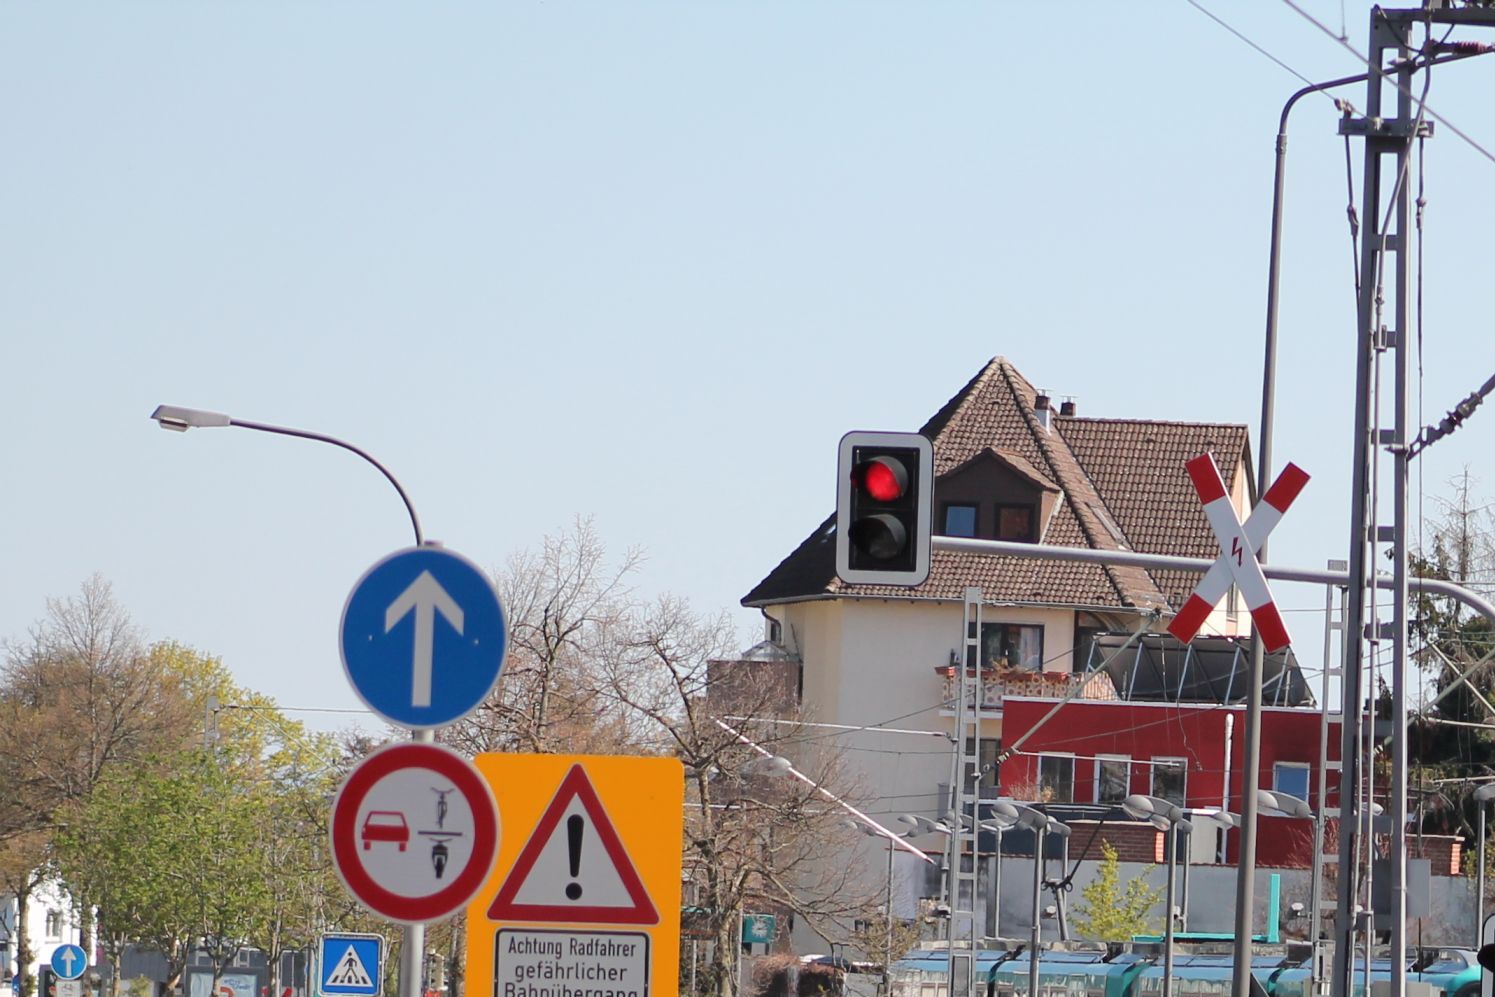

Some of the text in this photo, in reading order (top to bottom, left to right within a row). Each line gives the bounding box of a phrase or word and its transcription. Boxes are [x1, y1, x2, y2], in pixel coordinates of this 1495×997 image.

[508, 936, 636, 959] Achtung Radfahrer
[515, 961, 627, 982] gefährlicher
